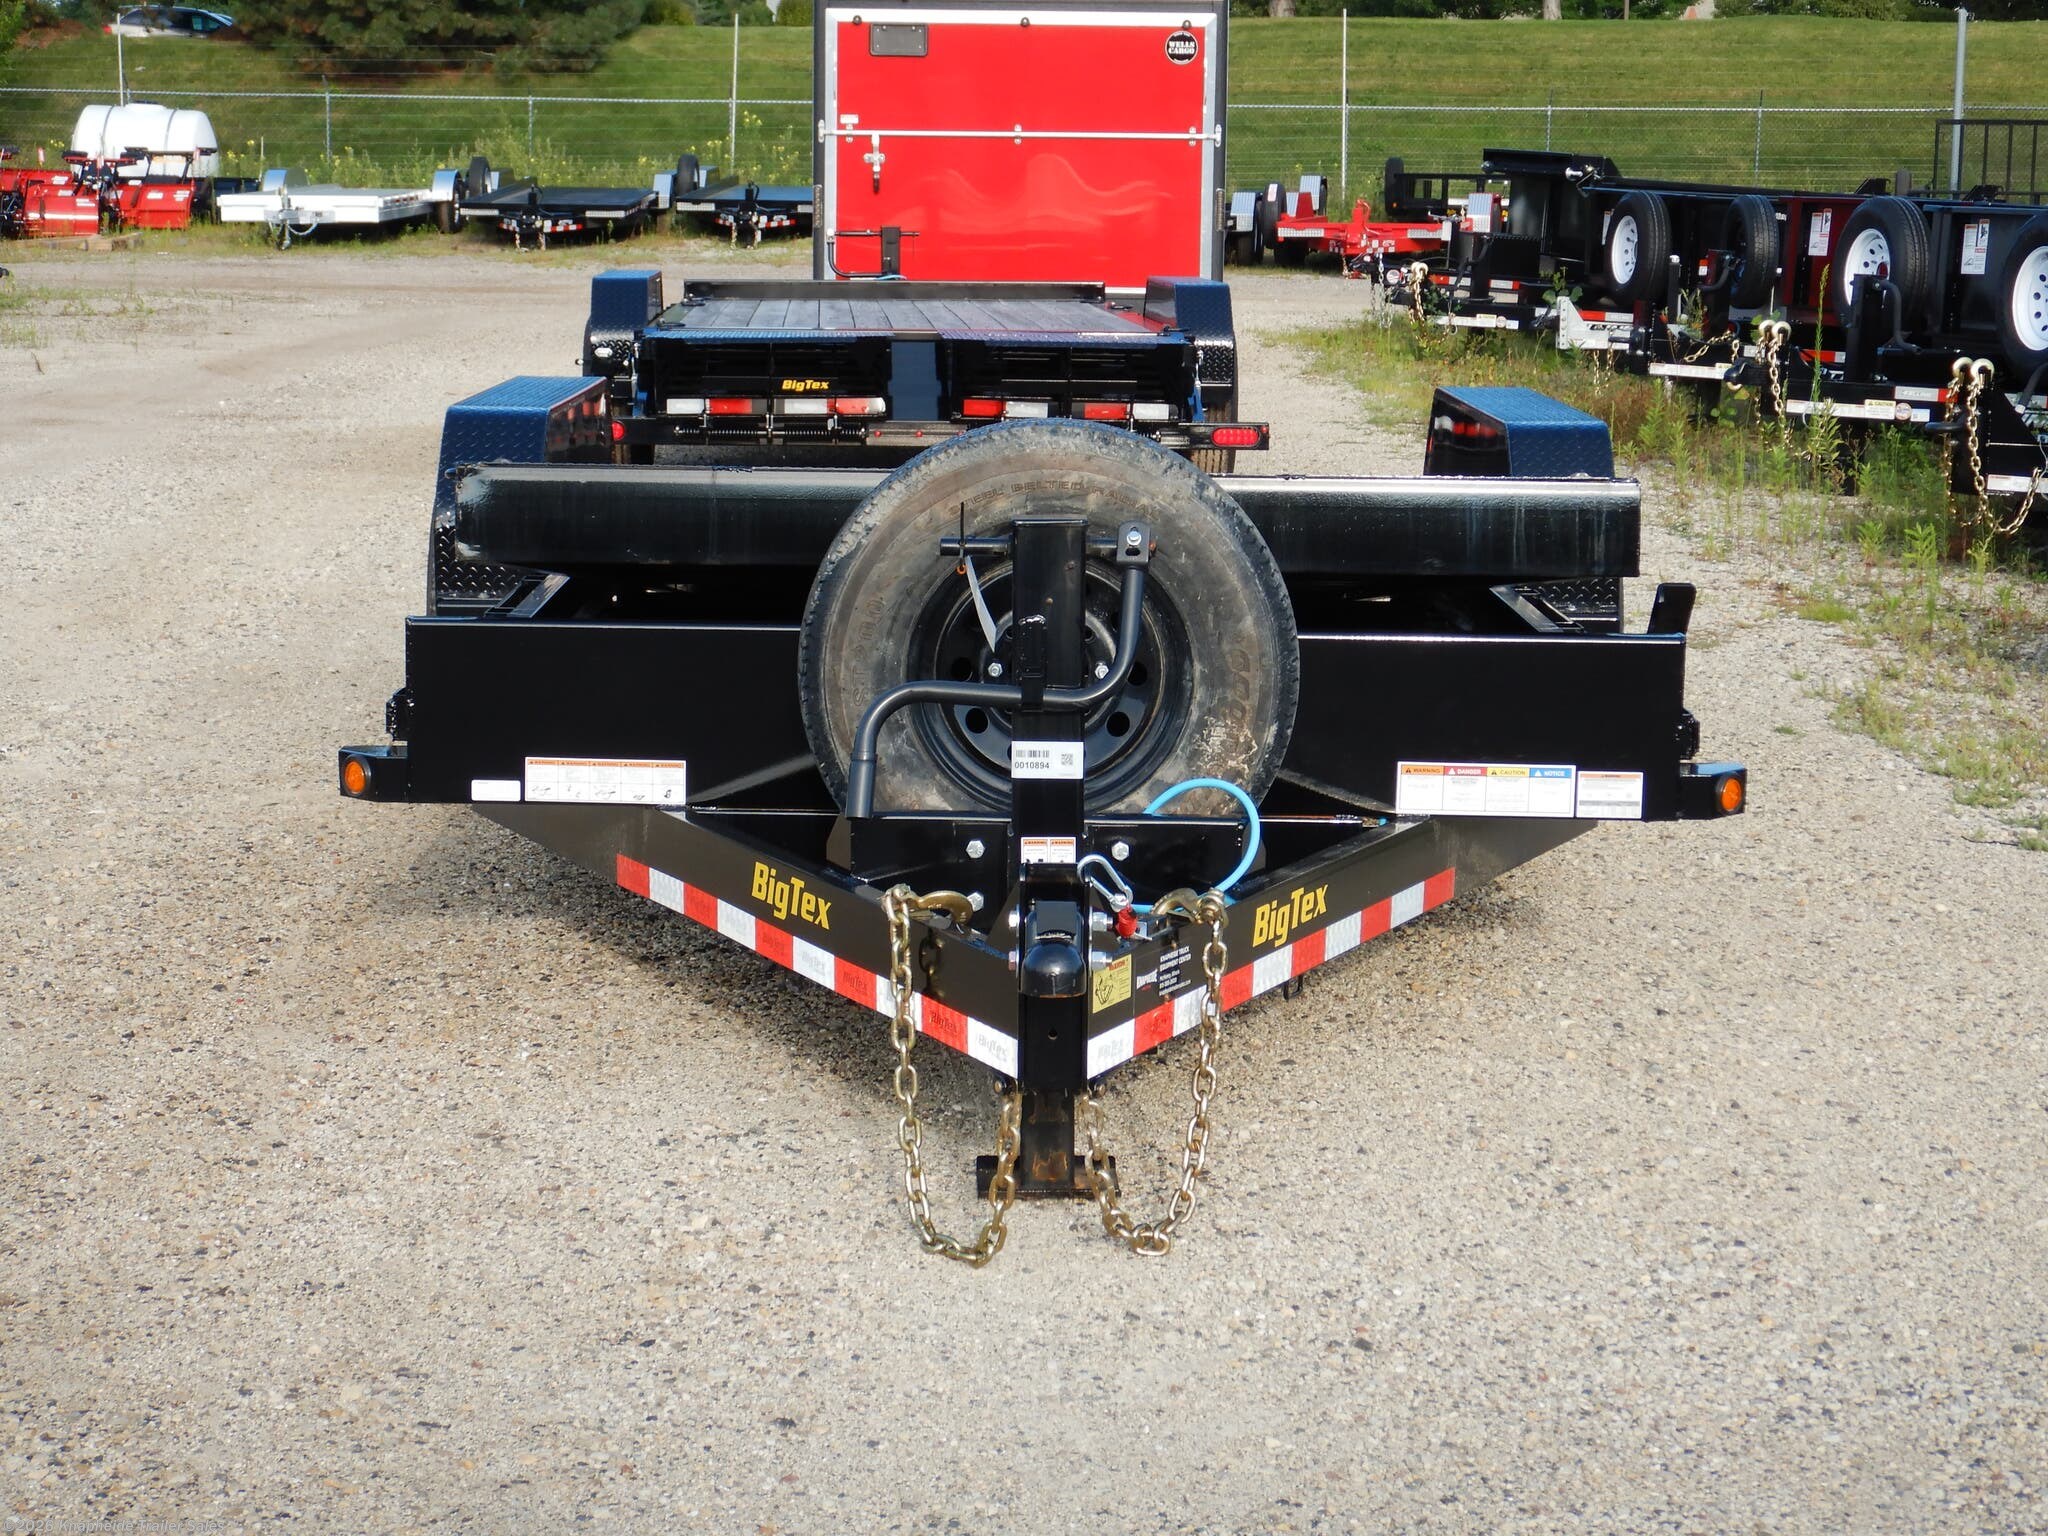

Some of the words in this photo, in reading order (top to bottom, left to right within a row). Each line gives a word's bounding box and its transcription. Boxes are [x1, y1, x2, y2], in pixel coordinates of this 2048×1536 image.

[1168, 40, 1196, 48] WELLS
[782, 379, 830, 392] BigTex
[1010, 479, 1086, 493] BELTED
[1014, 761, 1050, 769] 0010894
[752, 861, 832, 930] BigTex
[1252, 884, 1328, 948] BigTex
